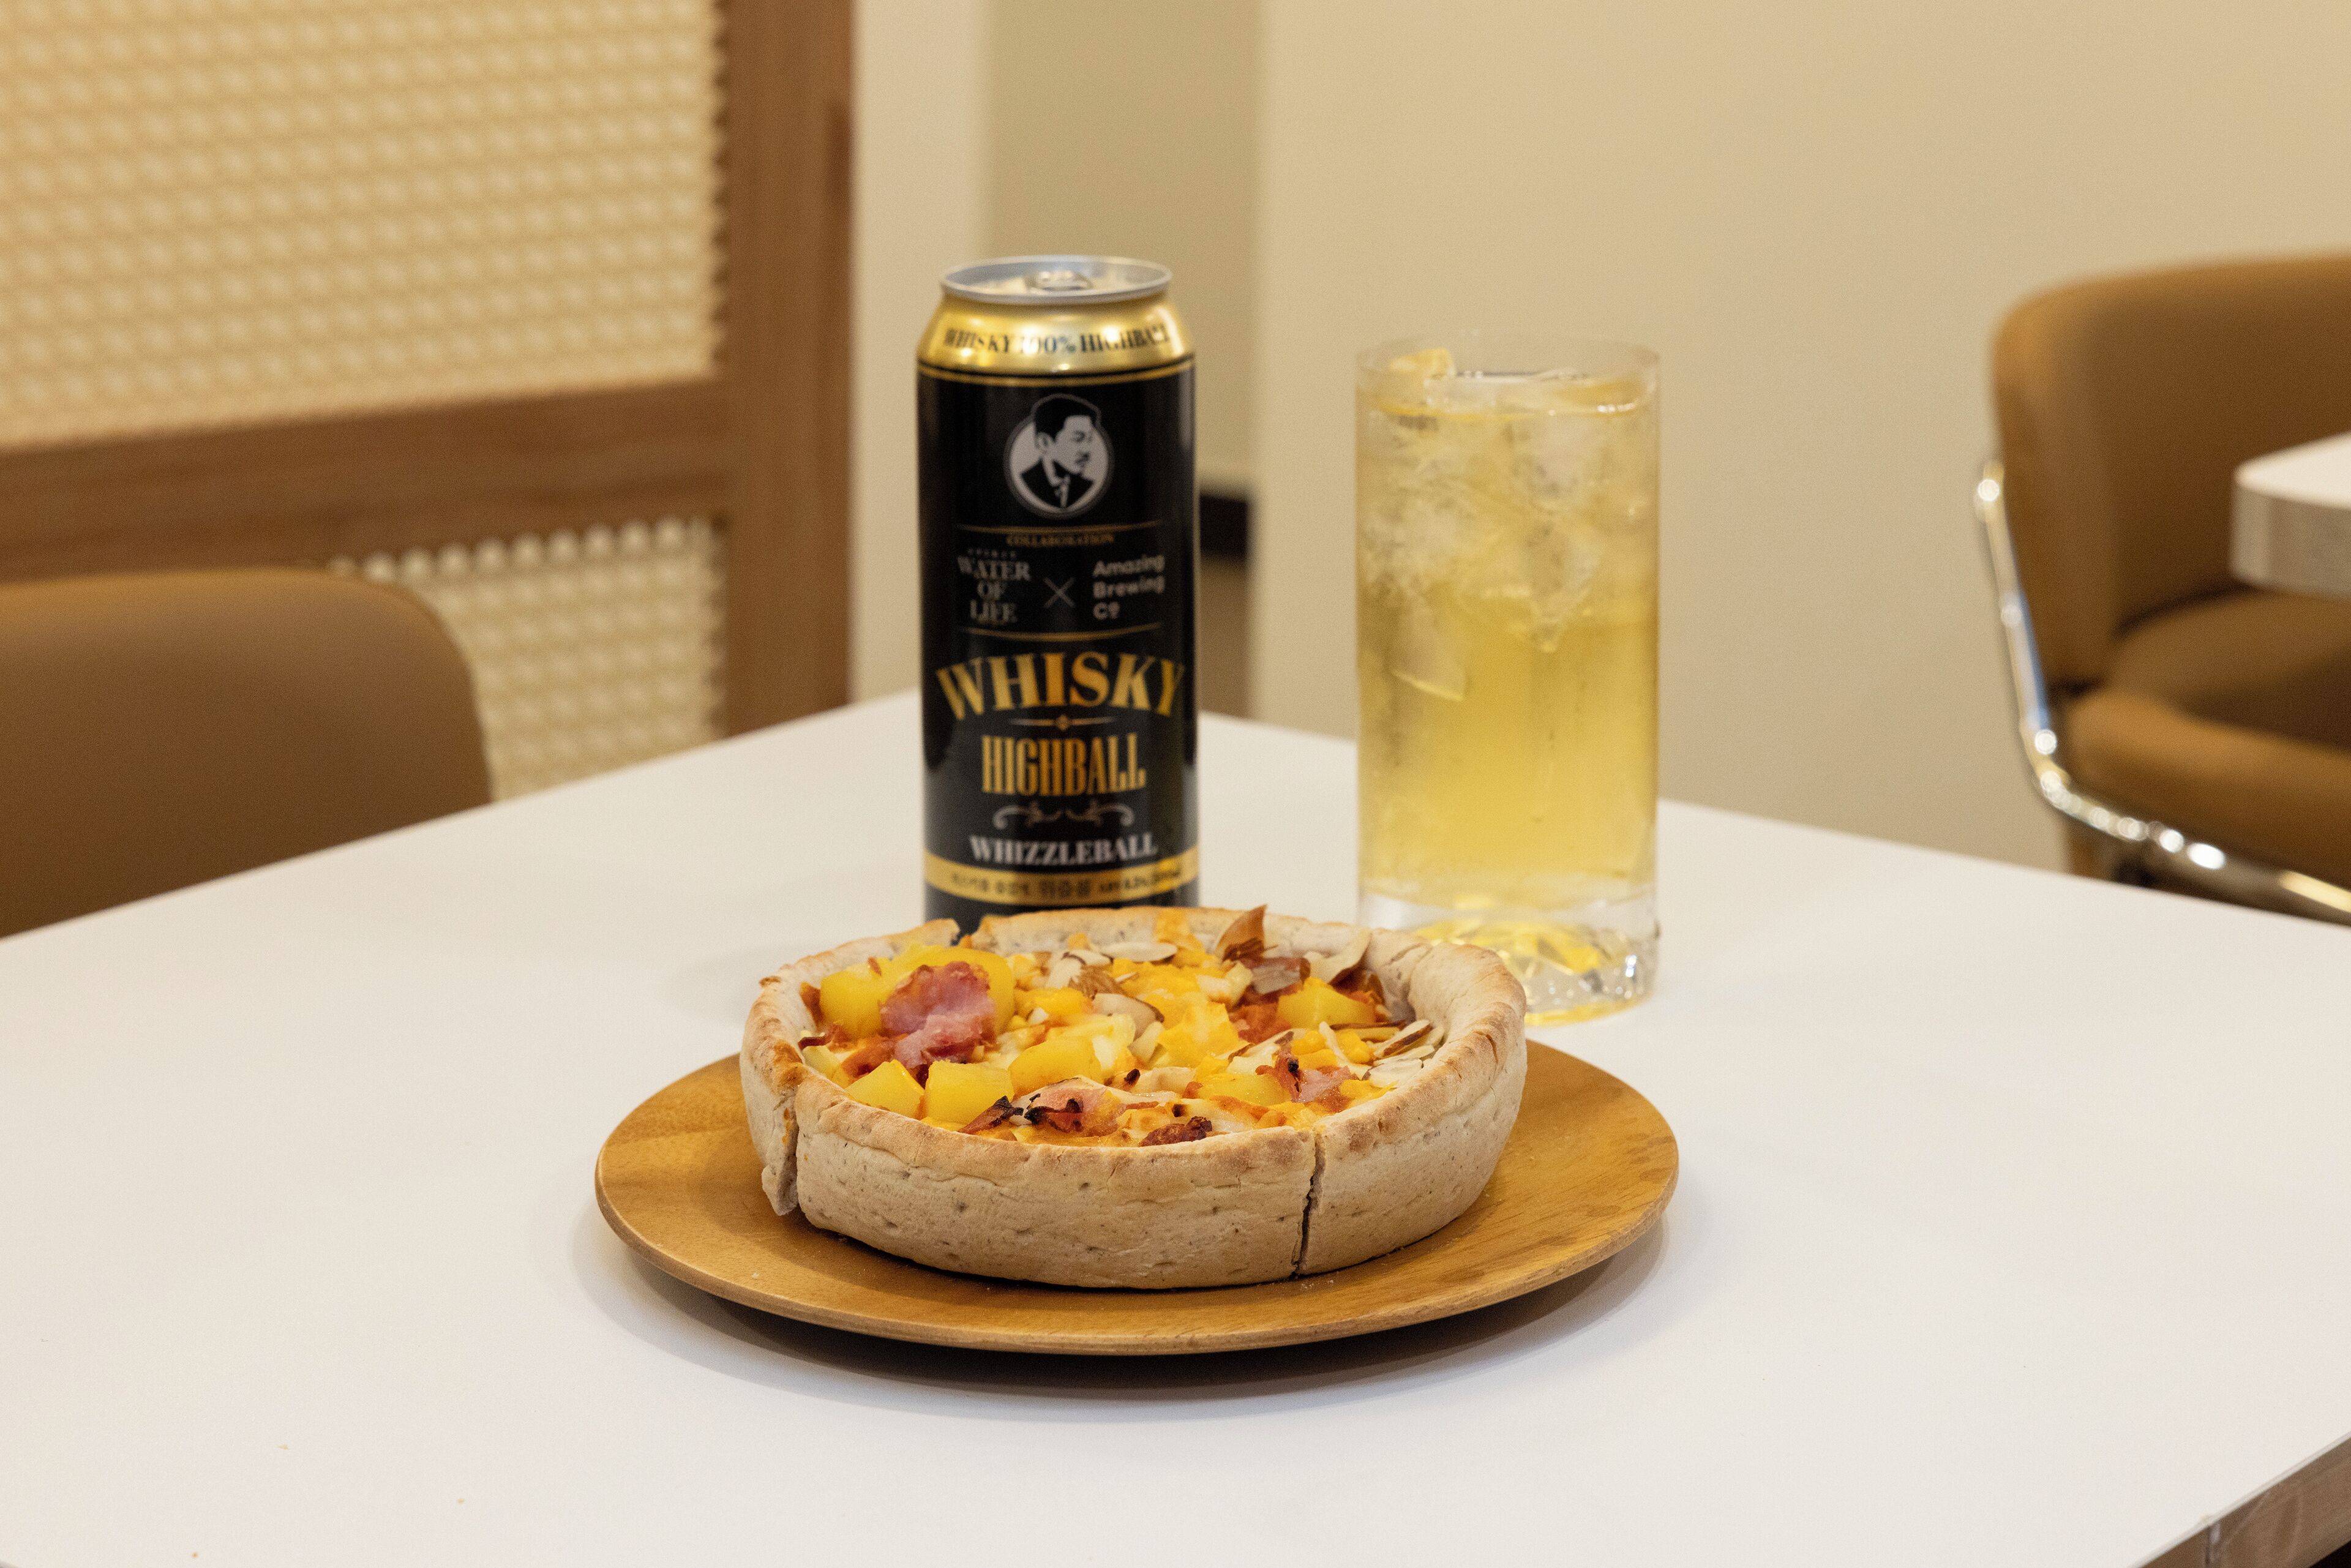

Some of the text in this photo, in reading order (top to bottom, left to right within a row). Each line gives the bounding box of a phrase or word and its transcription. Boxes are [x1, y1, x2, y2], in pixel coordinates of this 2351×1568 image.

[1019, 334, 1077, 354] 00%
[957, 555, 1031, 581] WATER
[1092, 553, 1165, 577] Amazing
[977, 582, 1006, 600] OF
[1093, 576, 1165, 599] Brewing
[936, 651, 1185, 720] WHISKY
[981, 732, 1147, 796] HIGHBALL
[969, 831, 1158, 866] WHIZZLEBALL
